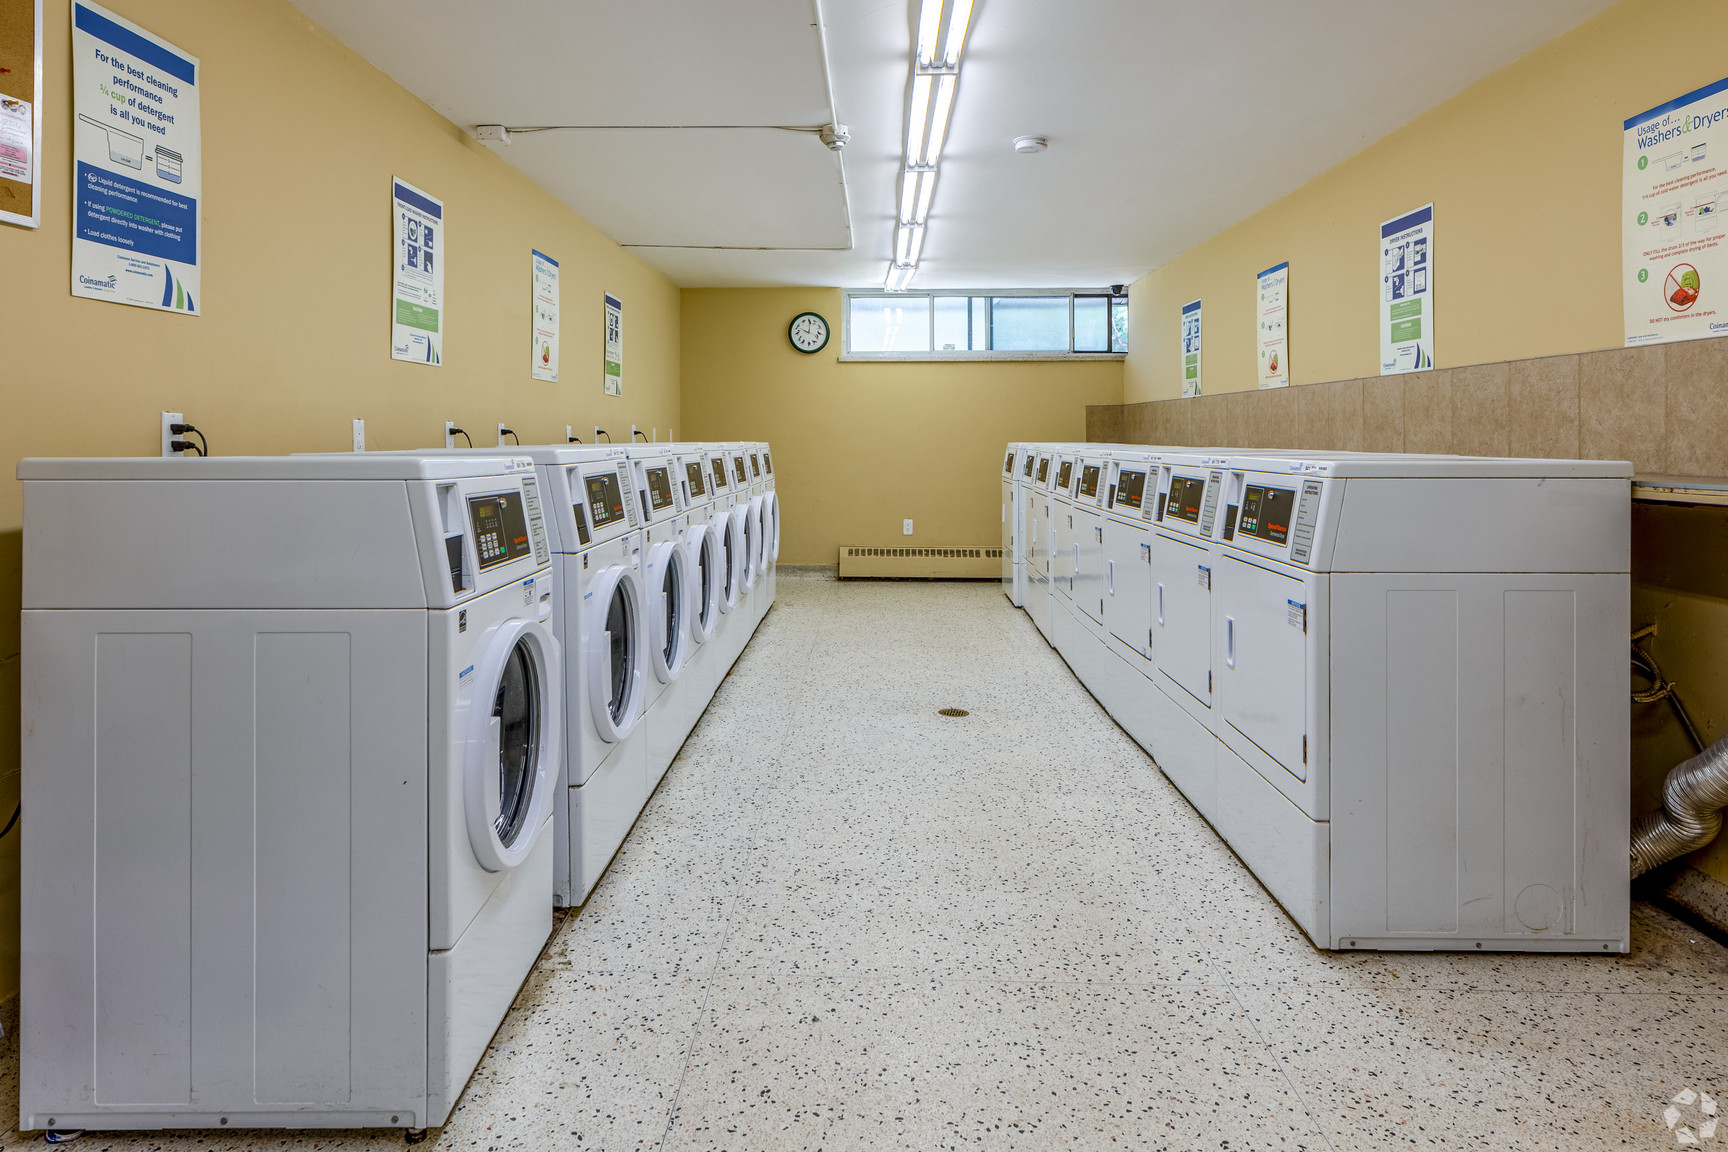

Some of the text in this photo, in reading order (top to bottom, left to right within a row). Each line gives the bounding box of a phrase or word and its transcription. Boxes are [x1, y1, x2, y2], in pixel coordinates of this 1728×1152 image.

[96, 49, 178, 98] For the best cleaning
[113, 75, 162, 104] performance
[110, 104, 165, 135] is all you need
[111, 91, 126, 104] cup
[128, 98, 136, 107] of
[138, 101, 174, 124] detergent
[1638, 122, 1660, 136] Usage
[1638, 125, 1681, 150] Washers
[1682, 115, 1693, 133] &
[88, 182, 137, 203] cleaning performance
[98, 175, 112, 187] Liquid
[114, 181, 135, 194] detergent
[141, 190, 171, 204] recommended
[178, 201, 187, 210] best
[1674, 175, 1689, 184] cleaning
[1680, 179, 1699, 188] detergent
[88, 211, 110, 224] detergent
[111, 216, 128, 228] directly
[138, 225, 154, 234] washer
[155, 228, 163, 236] with
[164, 230, 181, 242] clothing
[92, 202, 105, 212] using
[106, 206, 133, 219] POWDERED
[162, 222, 174, 231] please
[88, 229, 134, 246] Load clothes loosely
[80, 275, 116, 289] Coinamatic
